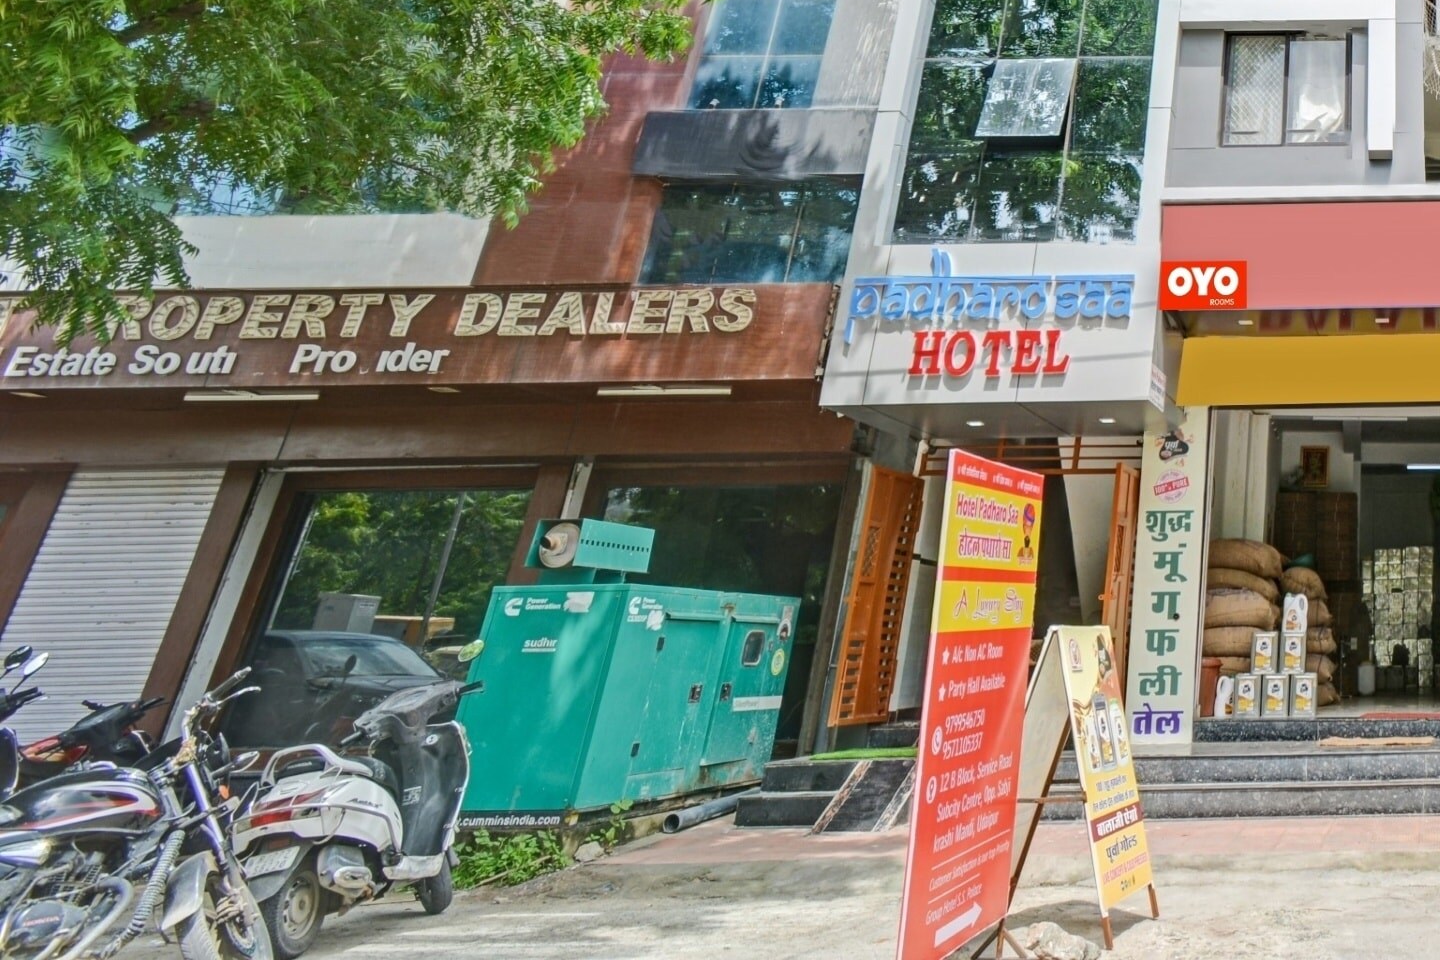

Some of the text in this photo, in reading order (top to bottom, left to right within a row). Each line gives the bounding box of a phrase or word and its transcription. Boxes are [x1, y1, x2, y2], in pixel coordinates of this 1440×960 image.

[845, 247, 1051, 345] padharo
[1167, 266, 1239, 297] OYO
[53, 293, 436, 341] ROPERTY
[454, 288, 757, 338] DEALERS
[1209, 298, 1235, 306] ROOMS
[4, 345, 117, 377] Estate
[907, 329, 1071, 378] HOTEL
[956, 492, 1019, 525] Hotel Padharo Saa
[1144, 509, 1194, 542] शुद्ध
[987, 642, 1003, 660] Room
[948, 679, 966, 700] Party
[980, 672, 1006, 692] Available
[1132, 702, 1184, 735] तेल
[939, 772, 950, 793] 12
[977, 758, 998, 779] Service
[998, 751, 1013, 771] Road
